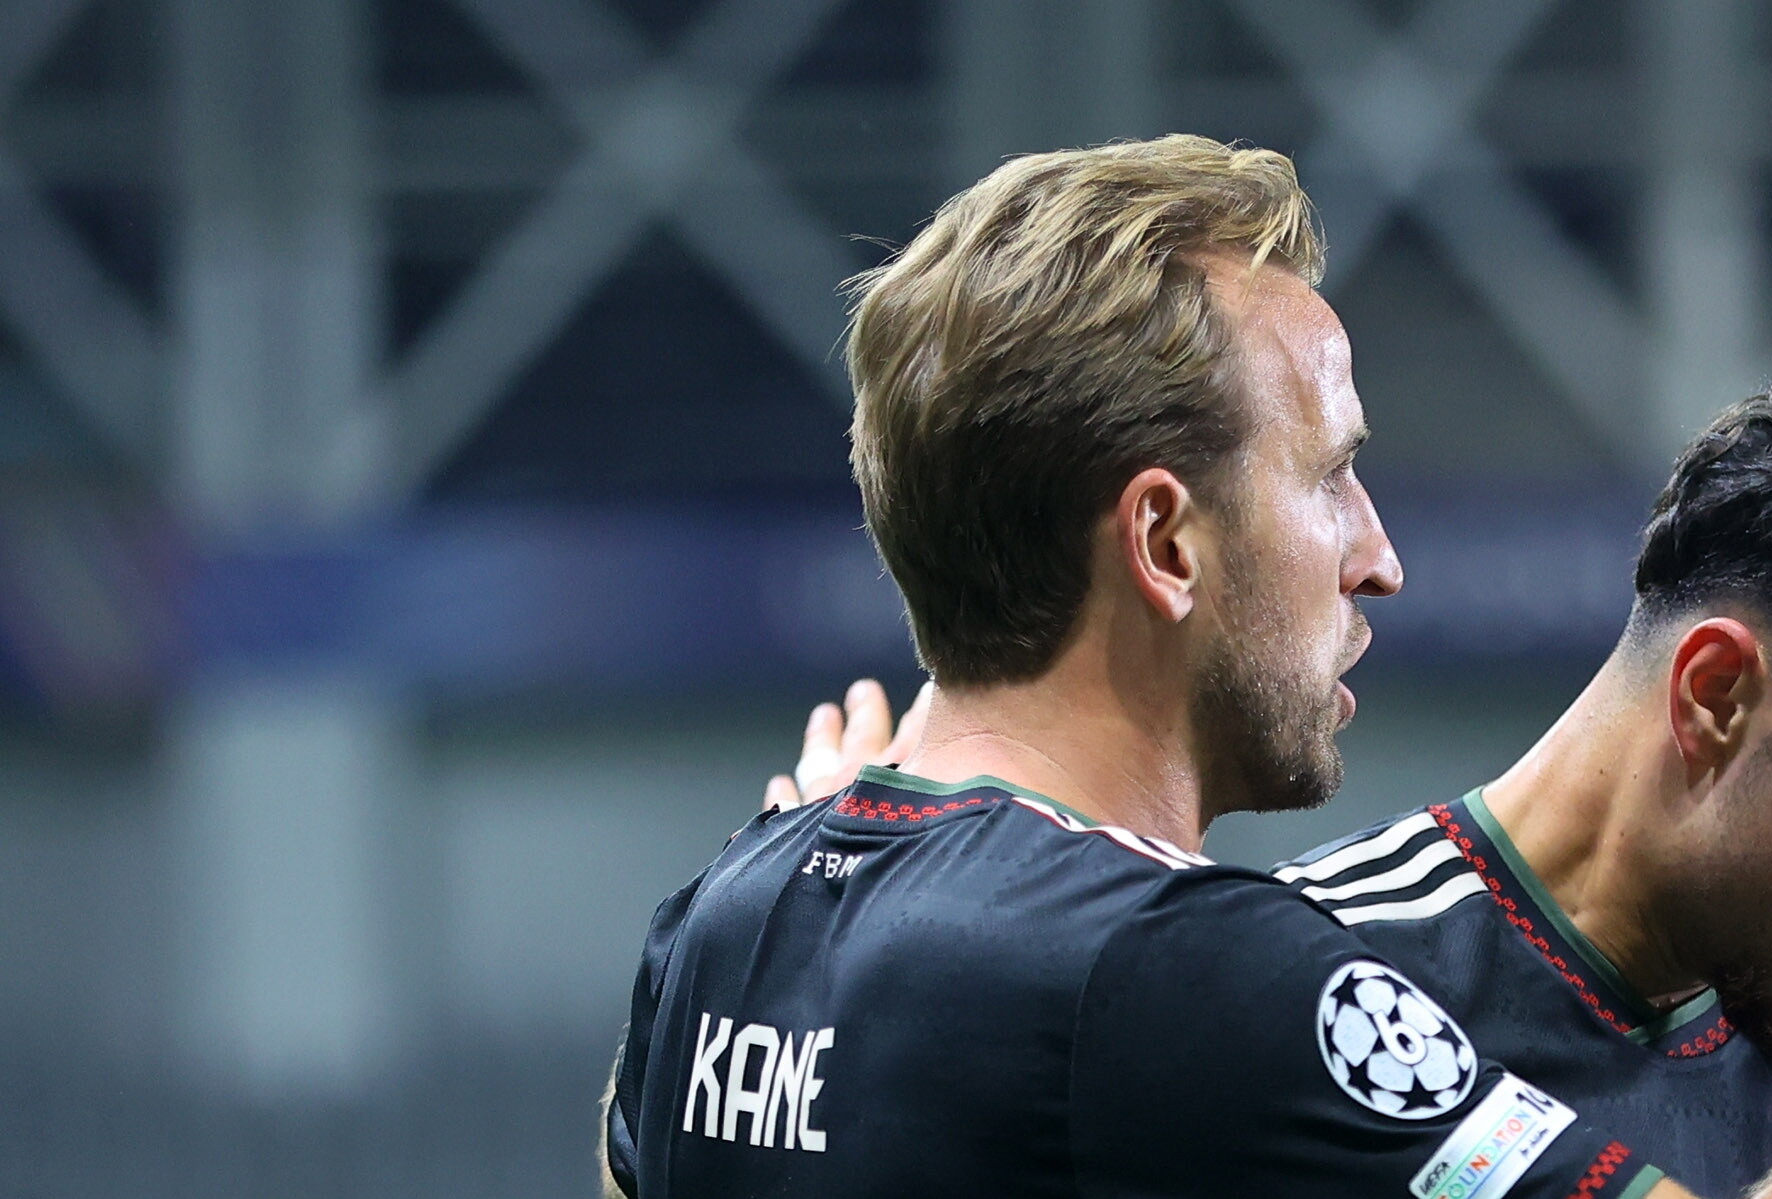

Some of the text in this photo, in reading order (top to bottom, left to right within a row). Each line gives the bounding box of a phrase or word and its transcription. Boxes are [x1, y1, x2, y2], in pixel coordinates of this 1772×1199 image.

[801, 851, 863, 879] FBM
[682, 1012, 835, 1153] KANE
[1419, 1161, 1450, 1196] UEFA
